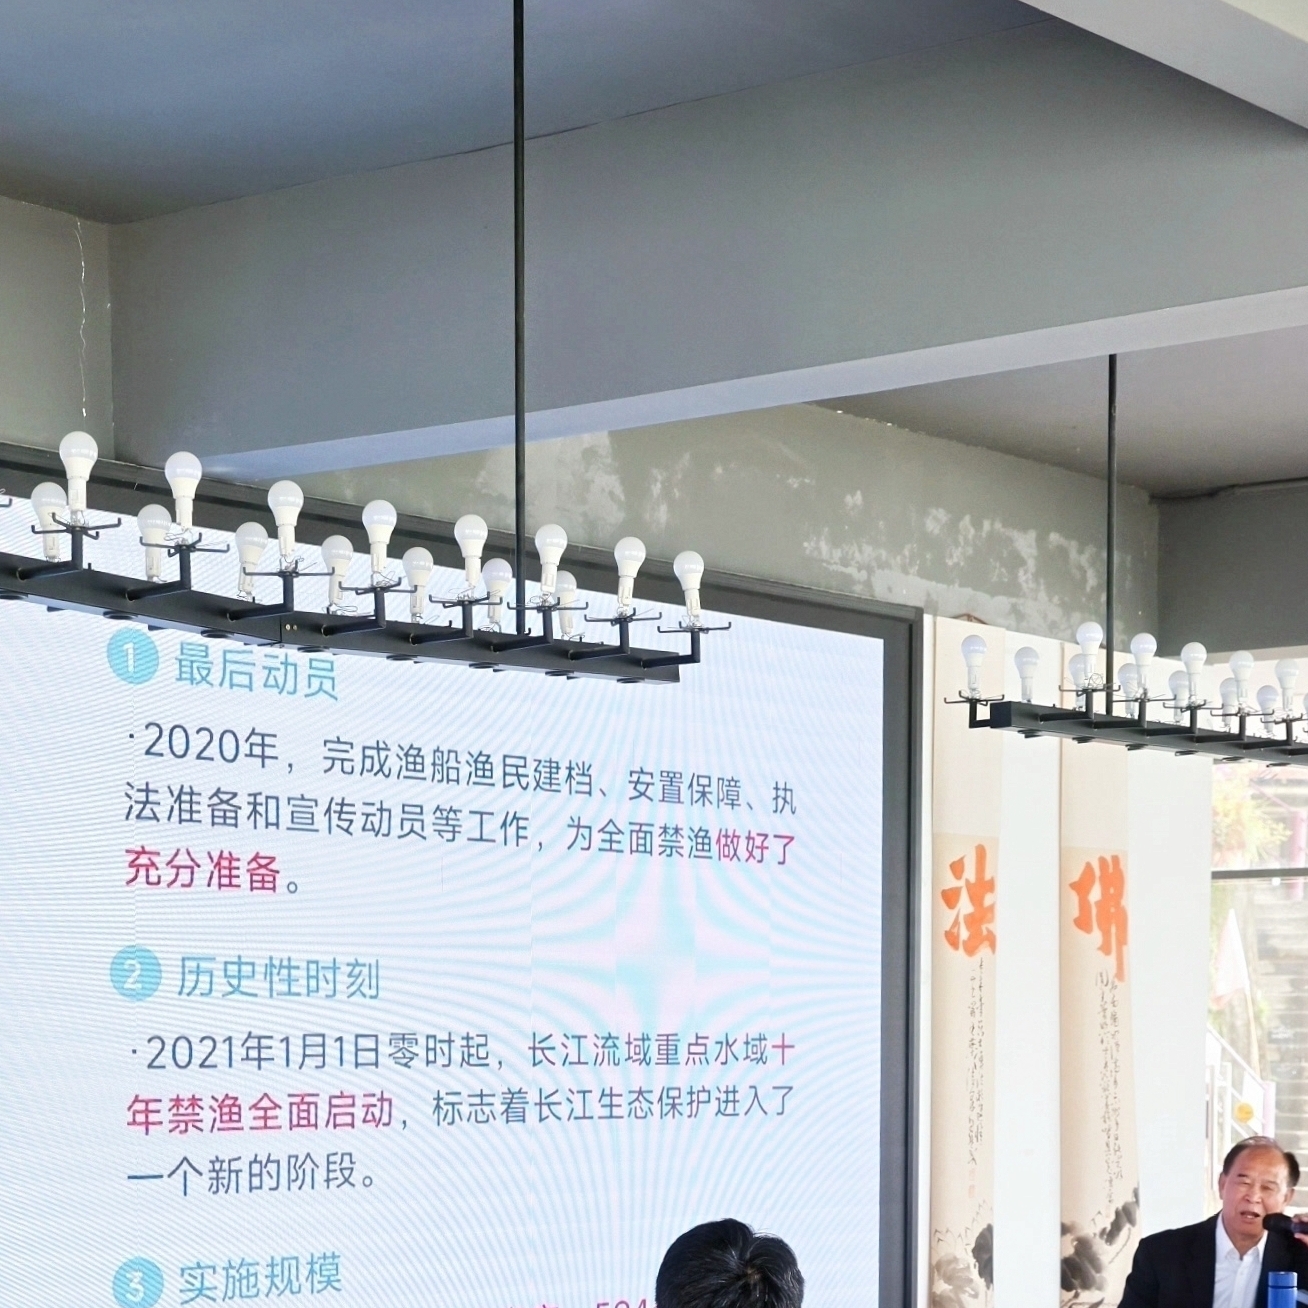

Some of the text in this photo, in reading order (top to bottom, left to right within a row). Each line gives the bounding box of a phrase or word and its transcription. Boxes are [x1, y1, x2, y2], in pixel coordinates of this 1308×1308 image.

[175, 640, 339, 702] 最后动员
[124, 846, 301, 896] 充分准备。
[176, 956, 381, 1001] 历史性时刻
[126, 1084, 795, 1135] 年禁渔全面启动，标志着长江生态保护进入了
[127, 1151, 376, 1197] 一个新的阶段。
[179, 1251, 343, 1306] 实施规模
